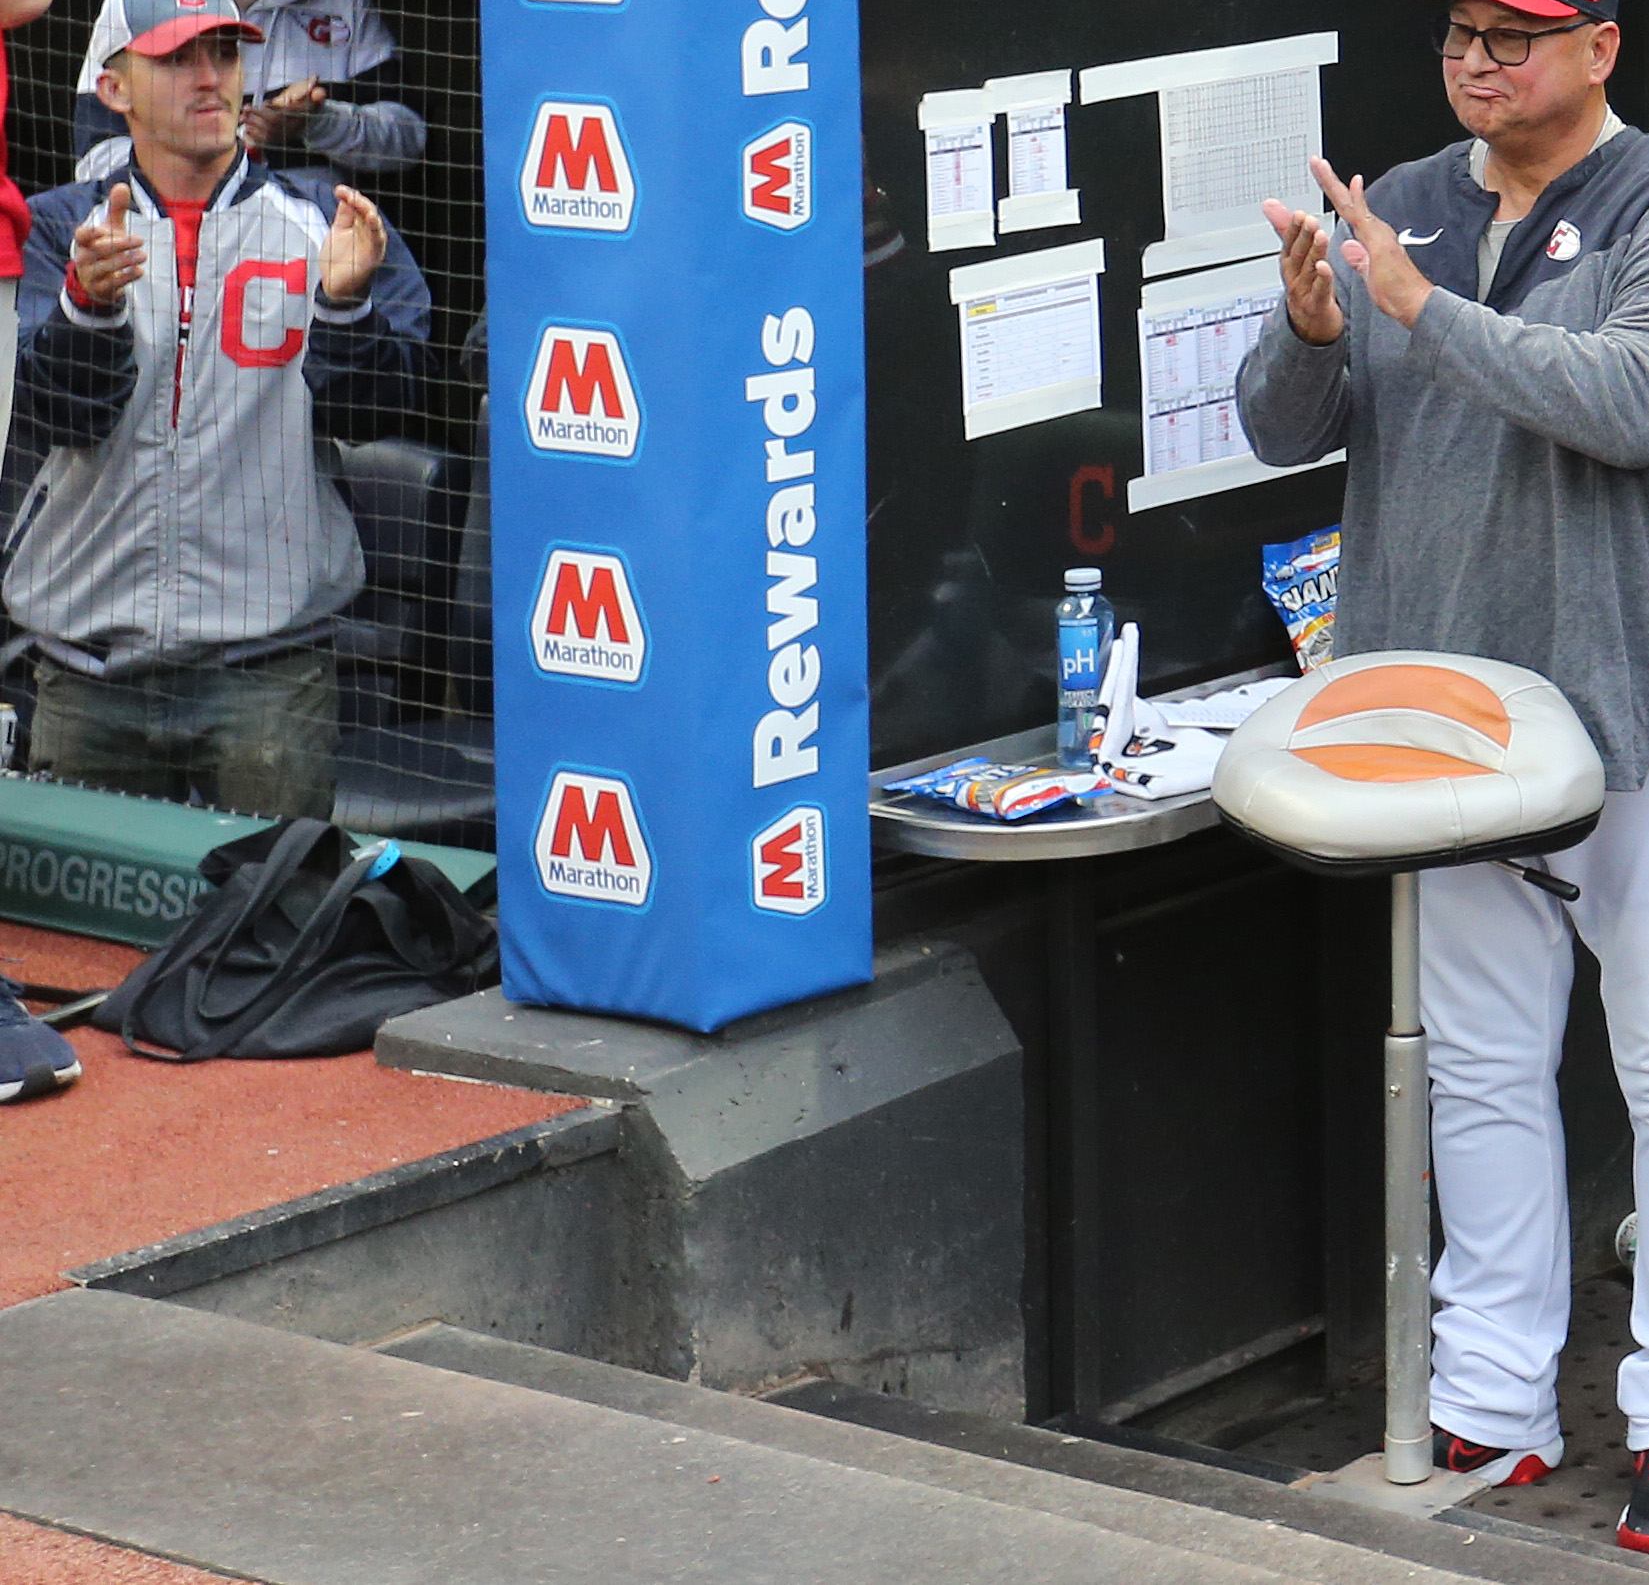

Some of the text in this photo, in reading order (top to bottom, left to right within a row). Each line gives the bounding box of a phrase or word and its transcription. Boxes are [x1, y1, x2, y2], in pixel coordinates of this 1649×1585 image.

[793, 132, 806, 215] Marathon
[533, 194, 623, 219] Marathon
[221, 258, 308, 369] C
[539, 418, 629, 446] Marathon
[1070, 465, 1115, 554] C
[745, 306, 822, 790] Rewards
[543, 640, 633, 671] Marathon
[1062, 648, 1096, 681] pH
[547, 859, 641, 894] Marathon
[805, 815, 818, 899] Marathon
